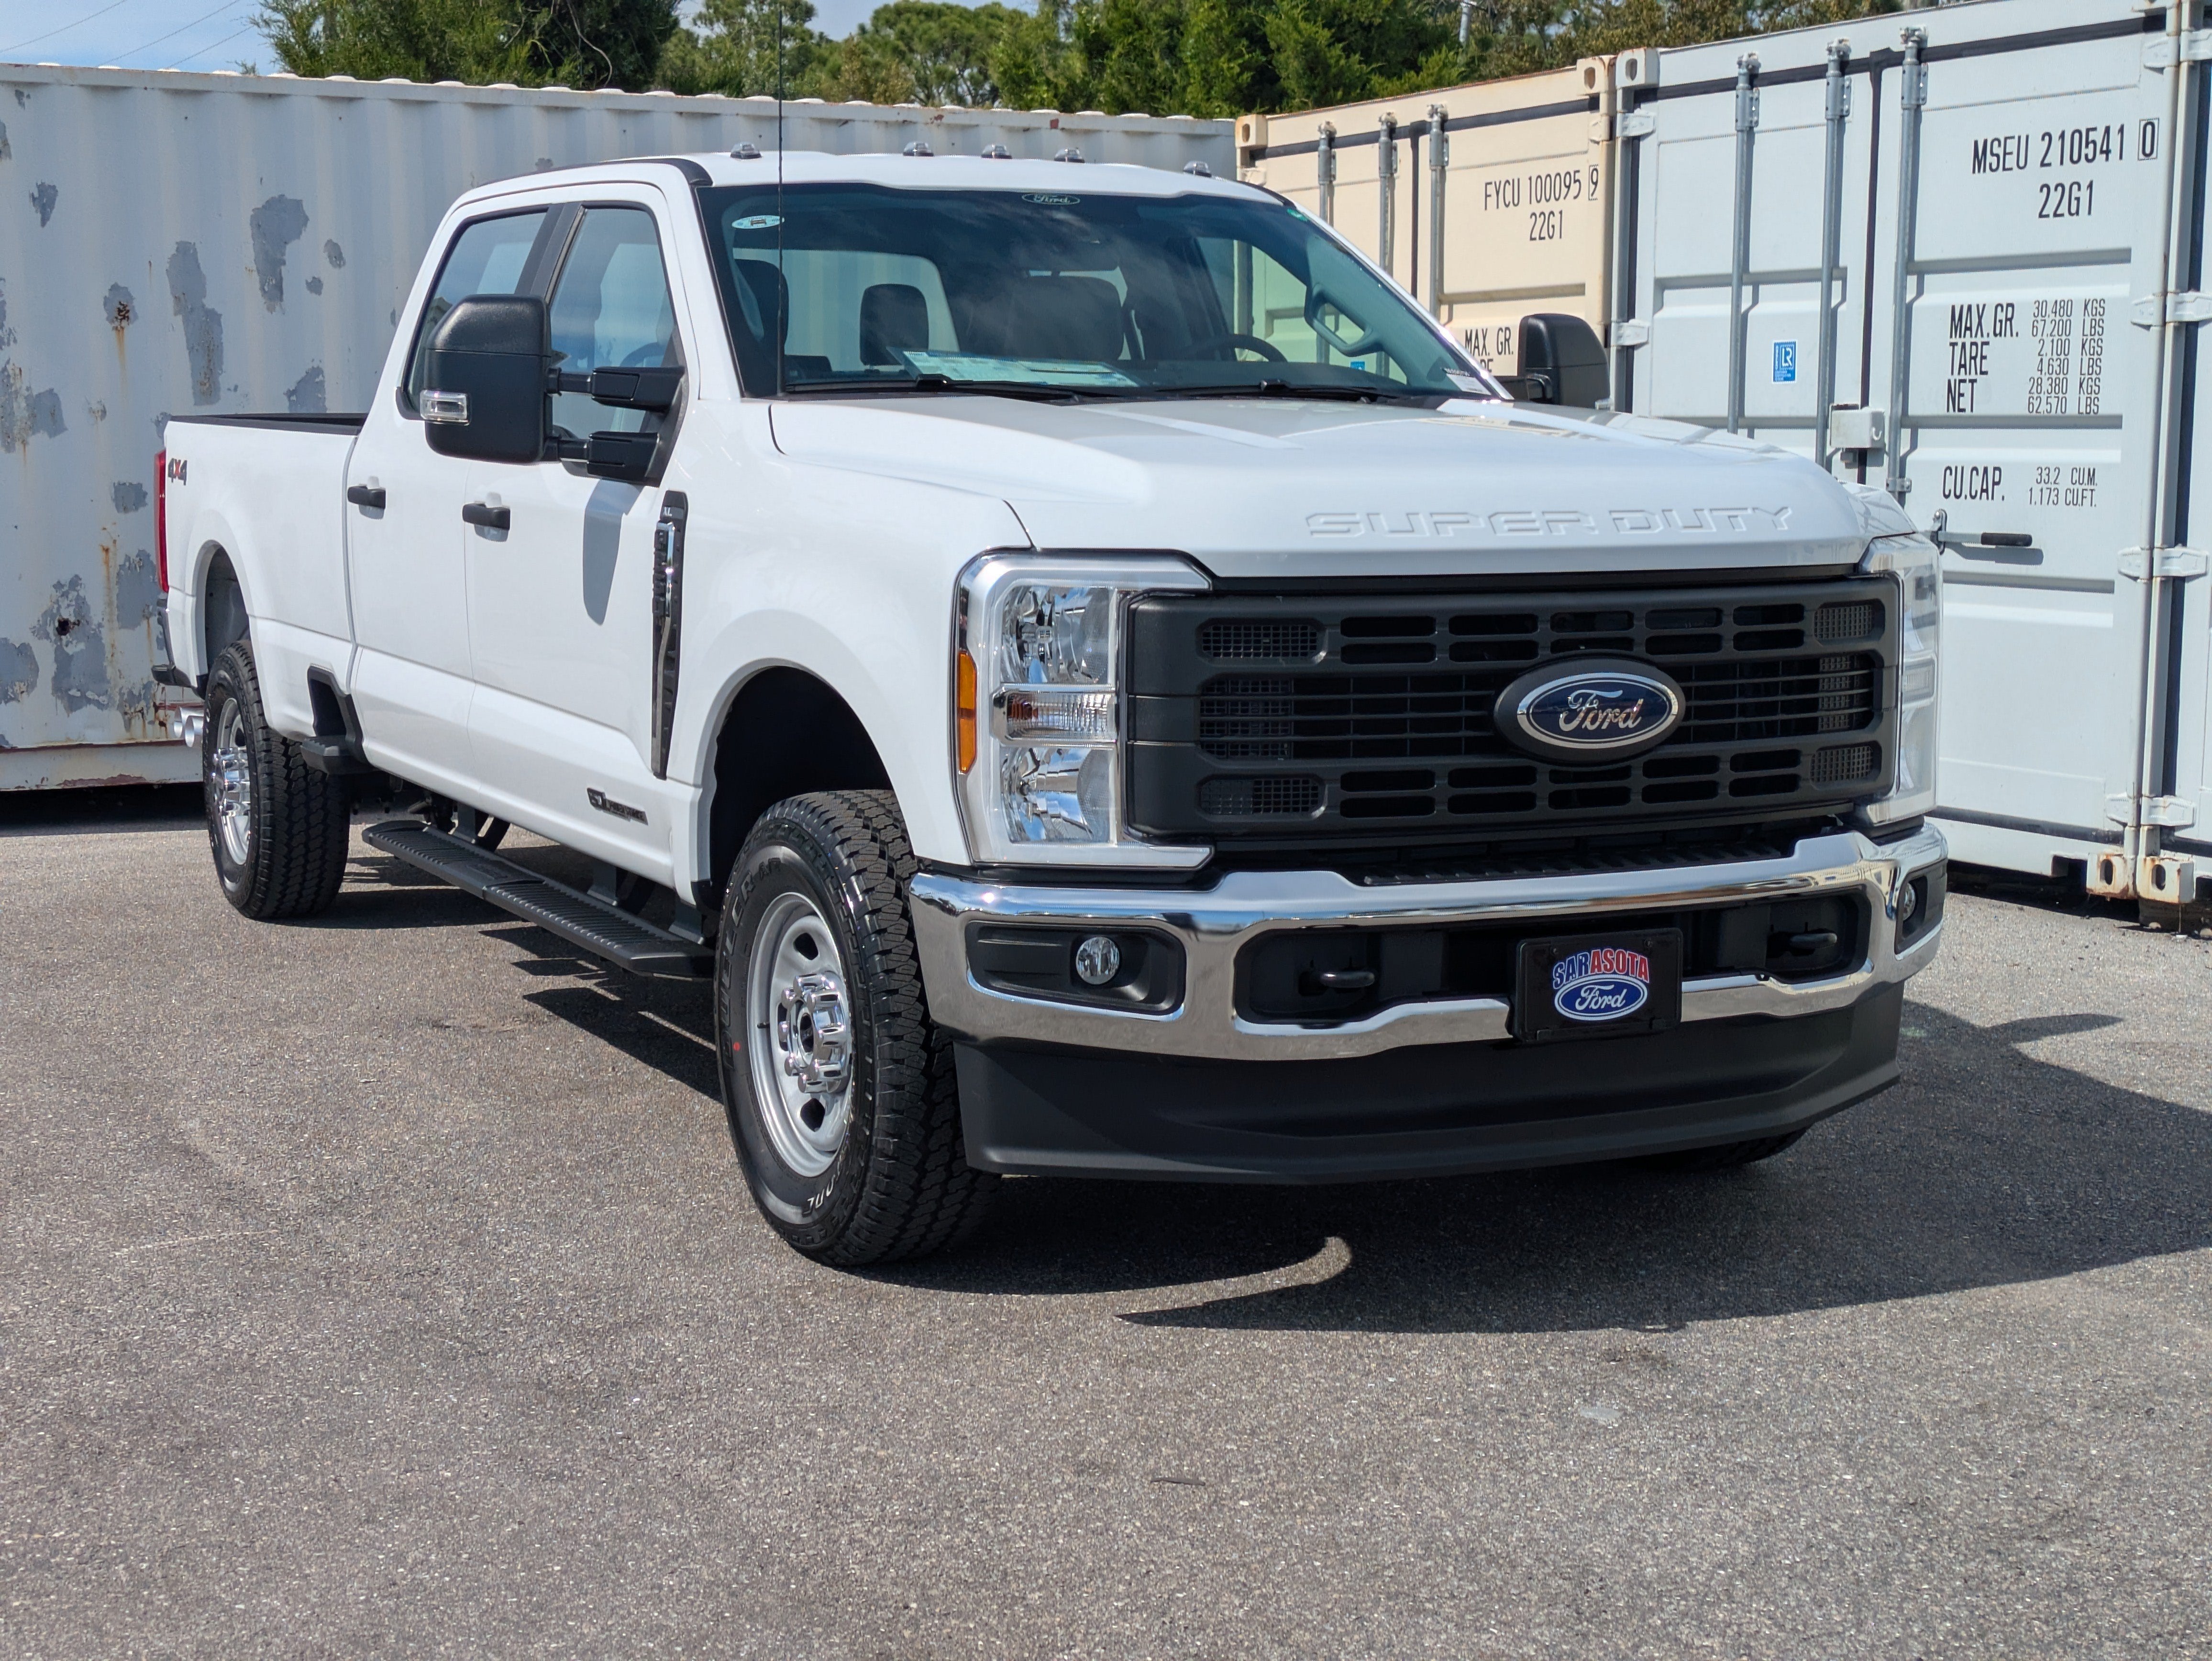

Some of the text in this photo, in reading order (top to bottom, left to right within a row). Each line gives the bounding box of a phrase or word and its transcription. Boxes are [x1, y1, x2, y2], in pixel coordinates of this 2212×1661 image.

[1972, 134, 2029, 174] MSEU
[2039, 124, 2125, 168] 210541
[1484, 167, 1599, 210] FYCU 100095 9
[2038, 180, 2094, 219] 22G1
[1530, 210, 1563, 241] 22G1
[2083, 298, 2105, 317] KGS
[1465, 327, 1514, 356] MAX. GR.
[2082, 318, 2104, 337] LBS
[1949, 341, 1990, 376] TARE
[2081, 338, 2103, 356] KGS
[2080, 357, 2101, 376] LBS
[1947, 378, 1977, 413] NET
[2079, 376, 2101, 396] KGS
[2078, 396, 2100, 415] LBS
[2036, 466, 2060, 485] 33.2
[2029, 487, 2059, 506] 1.173
[1305, 506, 1792, 538] SUPER DUTY
[1559, 689, 1644, 732] Ford
[1553, 948, 1649, 990] SARASOTA
[1574, 984, 1627, 1010] Ford
